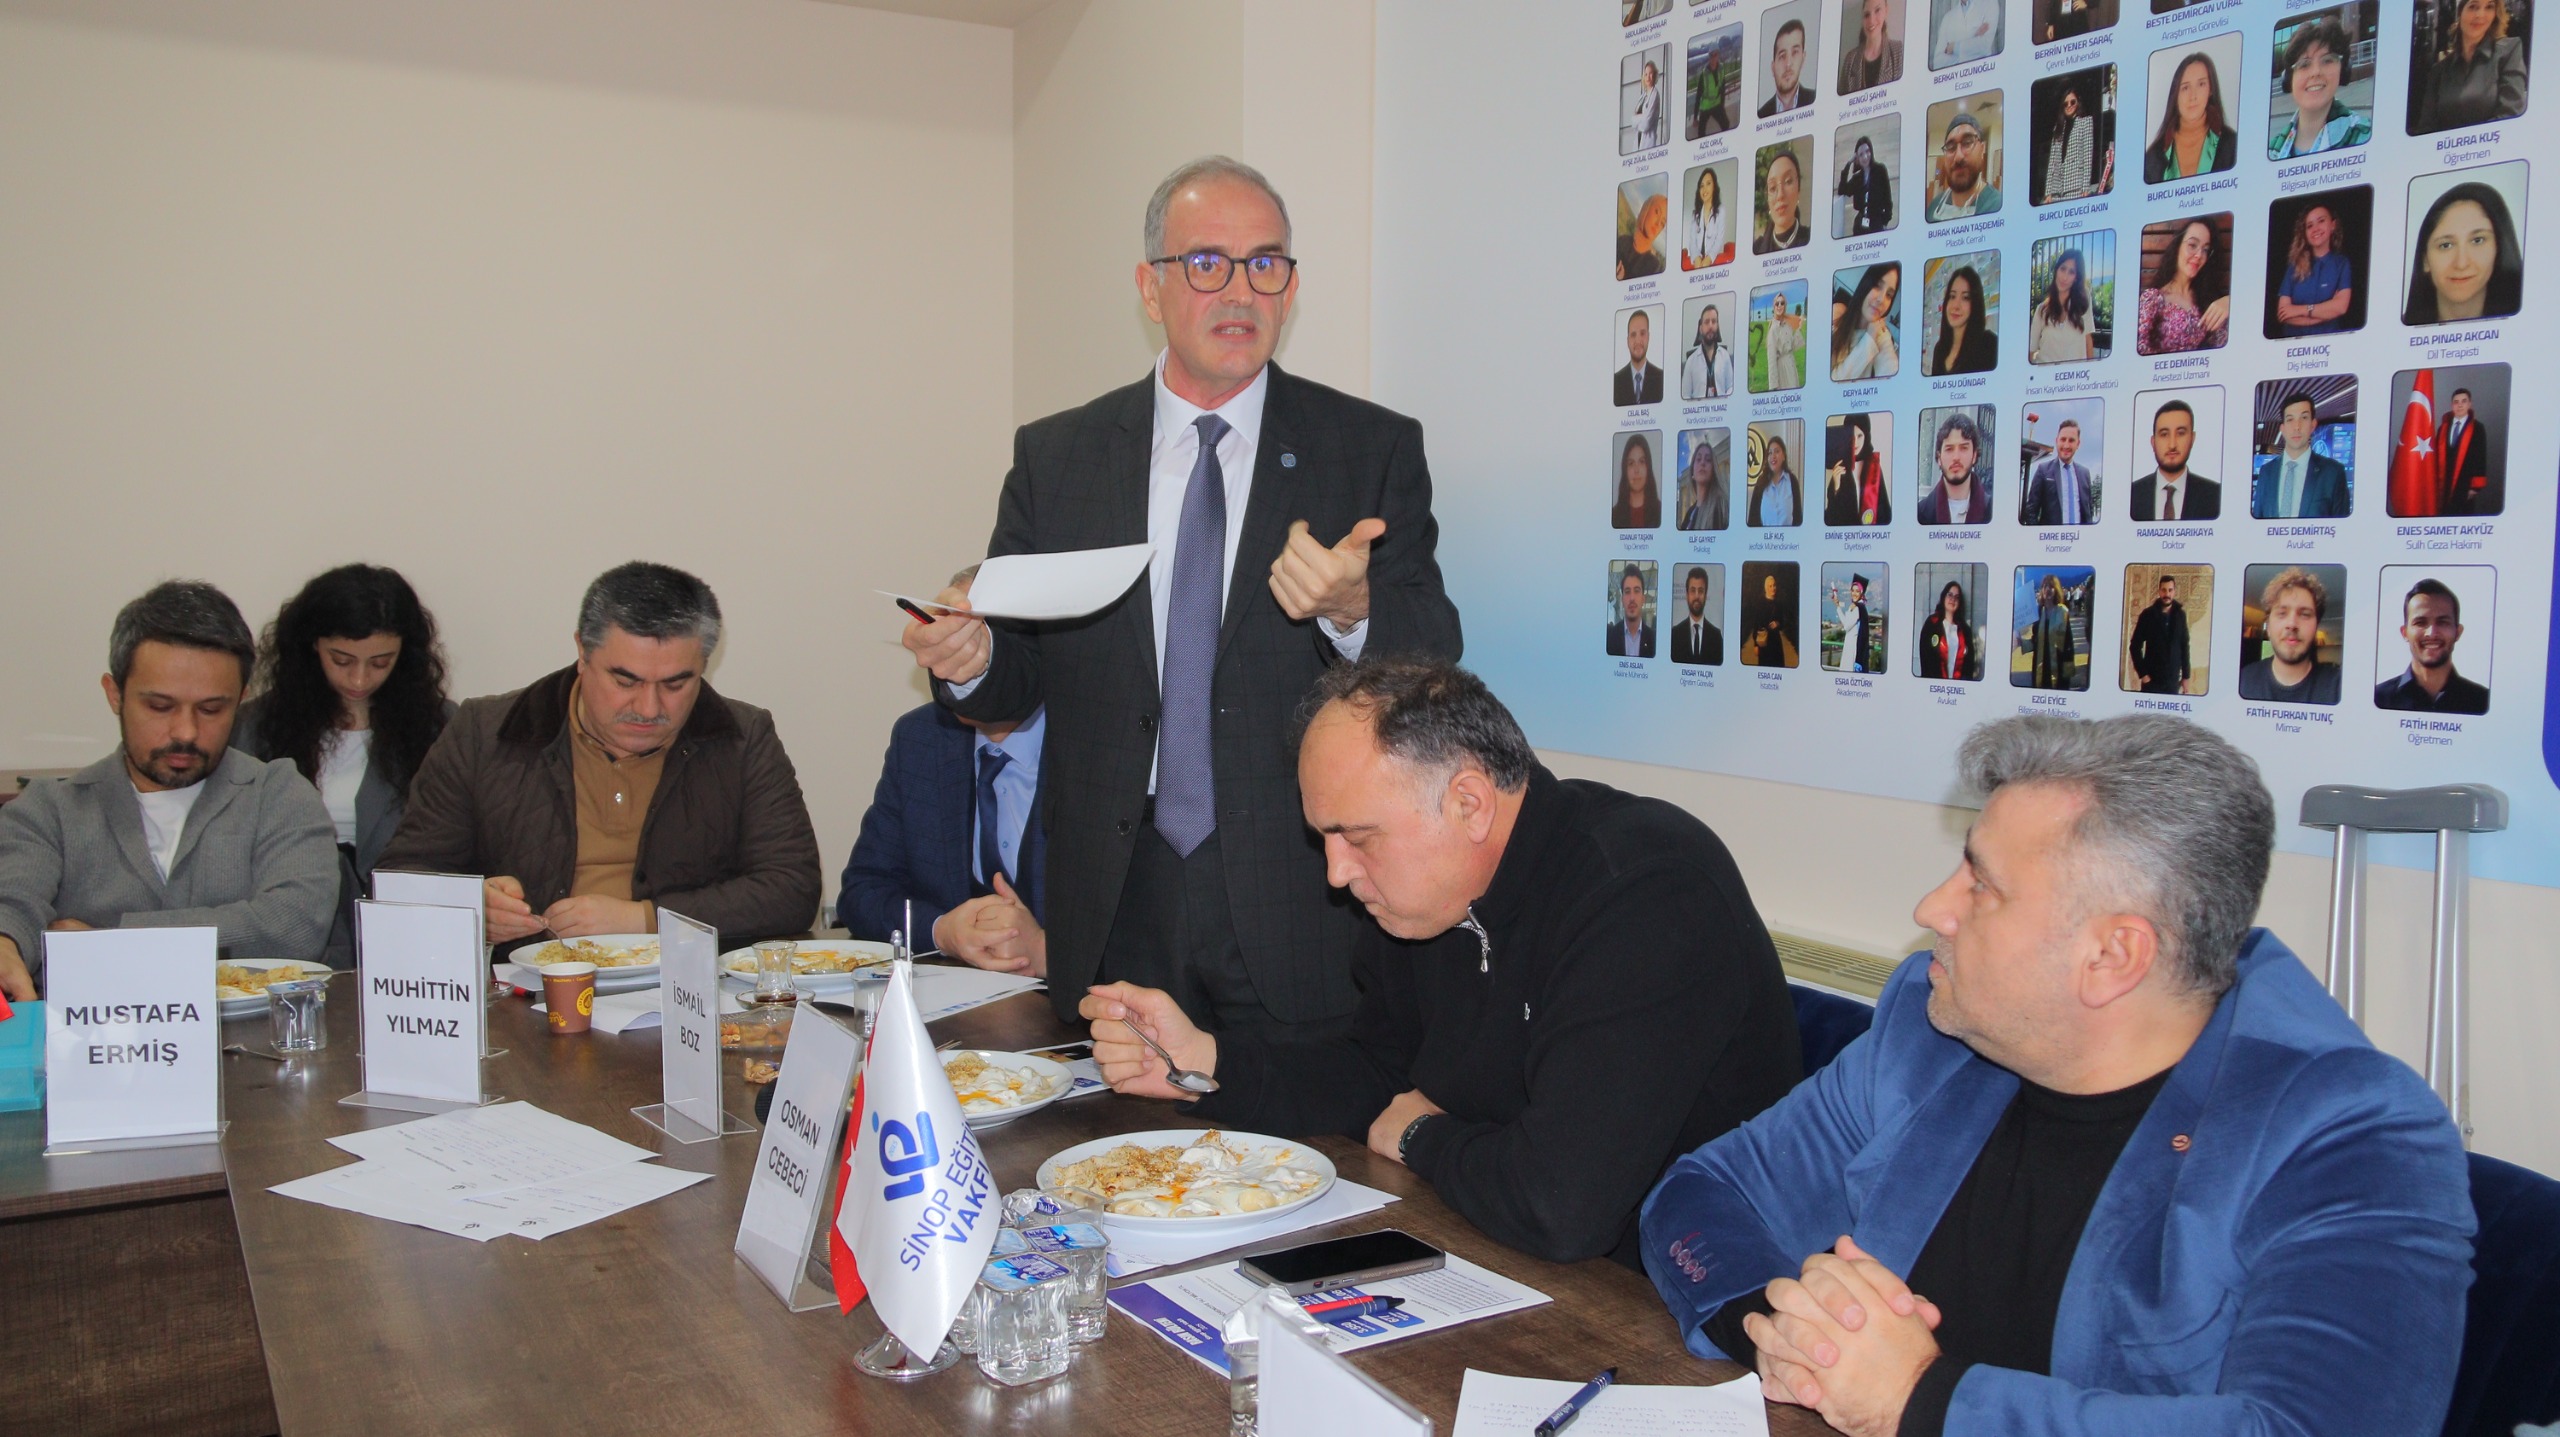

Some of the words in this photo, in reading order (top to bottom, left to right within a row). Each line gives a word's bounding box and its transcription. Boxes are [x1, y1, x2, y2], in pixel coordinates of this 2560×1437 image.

[2146, 16, 2170, 28] BESTE
[2172, 7, 2214, 23] DEMİRCAN
[2216, 0, 2243, 13] VURAL
[2162, 26, 2197, 41] Araştırma
[2198, 18, 2229, 33] Görevlisi
[2035, 44, 2061, 59] BERRİN
[2063, 39, 2087, 51] YENER
[2089, 33, 2113, 46] SARAÇ
[2046, 58, 2064, 71] Çevre
[2066, 50, 2100, 66] Mühendisi
[1934, 72, 1958, 84] BERKAY
[1960, 62, 1995, 79] UZUNOĞLU
[1849, 93, 1868, 106] BENGÜ
[1869, 89, 1887, 103] ŞAHİN
[1859, 105, 1872, 116] bölge
[1873, 100, 1897, 112] planlama
[1756, 118, 1776, 132] BAYRAM
[1777, 115, 1794, 127] BURAK
[2437, 134, 2476, 151] BÜLRRA
[2479, 130, 2500, 144] KUŞ
[2444, 149, 2491, 164] Öğretmen
[2278, 162, 2318, 178] BUSENUR
[2321, 151, 2366, 170] PEKMEZCİ
[2281, 179, 2316, 192] Bilgisayar
[2319, 168, 2361, 185] Mühendisi
[2148, 190, 2173, 201] BURCU
[2175, 184, 2209, 197] KARAYEL
[2211, 178, 2239, 191] BAGUÇ
[2179, 198, 2203, 209] Avukat
[2039, 210, 2063, 221] BURCU
[2065, 205, 2089, 218] DEVECİ
[2091, 203, 2108, 213] AKIN
[1928, 229, 1950, 238] BURAK
[1951, 226, 1969, 235] KAAN
[1970, 219, 2004, 232] TAŞDEMİR
[1845, 242, 1862, 252] BEYZA
[1864, 238, 1888, 249] TARAKÇI
[1946, 238, 1965, 247] Plastik
[1967, 235, 1985, 244] Cerrah
[1763, 257, 1788, 267] BEYZANUR
[1852, 251, 1880, 262] Ekonomist
[1690, 275, 1703, 283] BEYZA
[2410, 336, 2429, 346] EDA
[2432, 333, 2461, 344] PINAR
[2465, 329, 2499, 341] AKCAN
[2287, 348, 2311, 357] ECEM
[2312, 345, 2330, 357] KOÇ
[2428, 349, 2439, 359] Dil
[2441, 346, 2479, 359] Terapisti
[2155, 361, 2168, 370] ECE
[2170, 357, 2209, 368] DEMİRTAŞ
[2288, 362, 2300, 371] Diş
[2302, 359, 2328, 369] Hekimi
[2055, 371, 2074, 381] ECEM
[2076, 370, 2089, 380] KOÇ
[2153, 372, 2182, 383] Anestezi
[2184, 370, 2210, 379] Uzmanı
[1933, 380, 1946, 390] DİLA
[1958, 378, 1986, 387] DÜNDAR
[1843, 389, 1862, 397] DERYA
[1825, 531, 1843, 539] EMİNE
[1844, 530, 1870, 540] ŞENTÜRK
[1929, 530, 1958, 539] EMİRHAN
[1960, 531, 1981, 539] DENGE
[2039, 533, 2060, 541] EMRE
[2061, 531, 2079, 542] BEŞLİ
[2137, 529, 2174, 537] RAMAZAN
[2176, 528, 2213, 536] SARIKAYA
[2267, 527, 2289, 536] ENES
[2291, 523, 2336, 538] DEMİRTAŞ
[2397, 526, 2421, 536] ENES
[2424, 526, 2458, 535] SAMET
[2461, 523, 2493, 534] AKYÜZ
[1946, 542, 1964, 551] Maliye
[2046, 545, 2072, 553] Komiser
[2162, 541, 2185, 550] Doktor
[2287, 540, 2314, 548] Avukat
[2406, 540, 2424, 549] Sulh
[2427, 541, 2448, 549] Ceza
[2451, 539, 2482, 549] Hakimi
[1850, 677, 1872, 687] ÖZTÜRK
[1930, 685, 1945, 693] ESRA
[1947, 687, 1965, 695] ŞENEL
[2032, 695, 2046, 704] EZGİ
[2048, 696, 2066, 705] EYİCE
[2135, 700, 2156, 708] FATİH
[2158, 702, 2179, 710] EMRE
[2181, 703, 2192, 713] ÇİL
[2247, 706, 2270, 718] FATİH
[2272, 710, 2307, 720] FURKAN
[2310, 712, 2333, 724] TUNÇ
[2276, 724, 2301, 733] Mimar
[2400, 717, 2427, 729] FATİH
[2430, 722, 2461, 732] IRMAK
[2408, 732, 2452, 746] Öğretmen
[373, 976, 470, 1003] MUHİTTİN
[673, 980, 706, 1019] İSMAİL
[65, 1004, 200, 1026] MUSTAFA
[386, 1014, 459, 1039] YILMAZ
[680, 1026, 700, 1053] BOZ
[89, 1039, 179, 1066] ERMİŞ
[781, 1100, 821, 1149] OSMAN
[768, 1146, 809, 1198] CEBECİ
[944, 1159, 989, 1244] VAKFI
[900, 1188, 951, 1272] SİNOP
